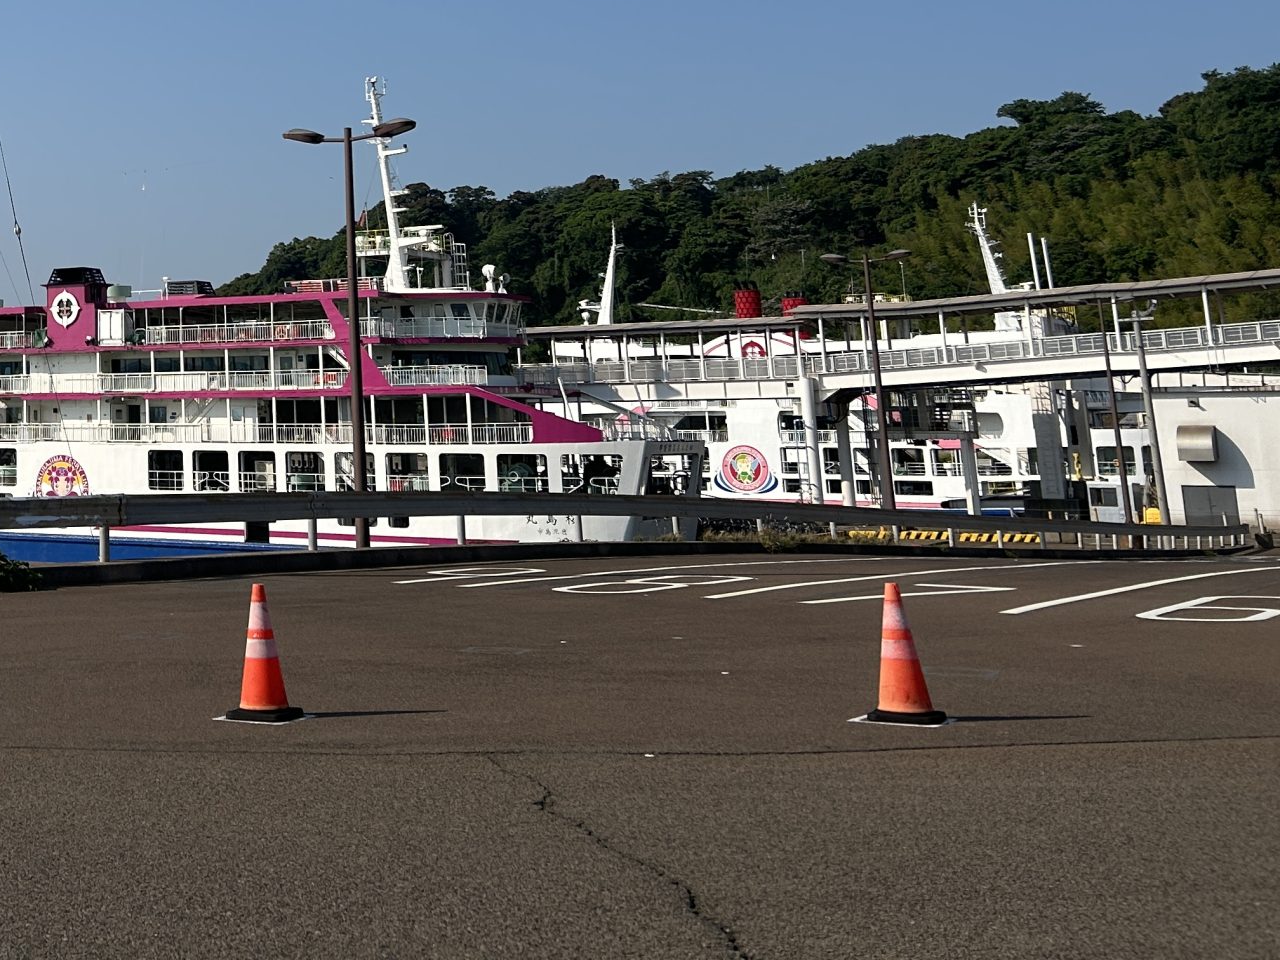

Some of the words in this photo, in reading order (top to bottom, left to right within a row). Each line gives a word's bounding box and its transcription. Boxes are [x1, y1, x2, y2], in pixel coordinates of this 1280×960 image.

[36, 455, 63, 493] SAKURAJIMA
[64, 456, 82, 473] FERRY
[552, 575, 756, 594] 8
[797, 583, 1017, 605] 7
